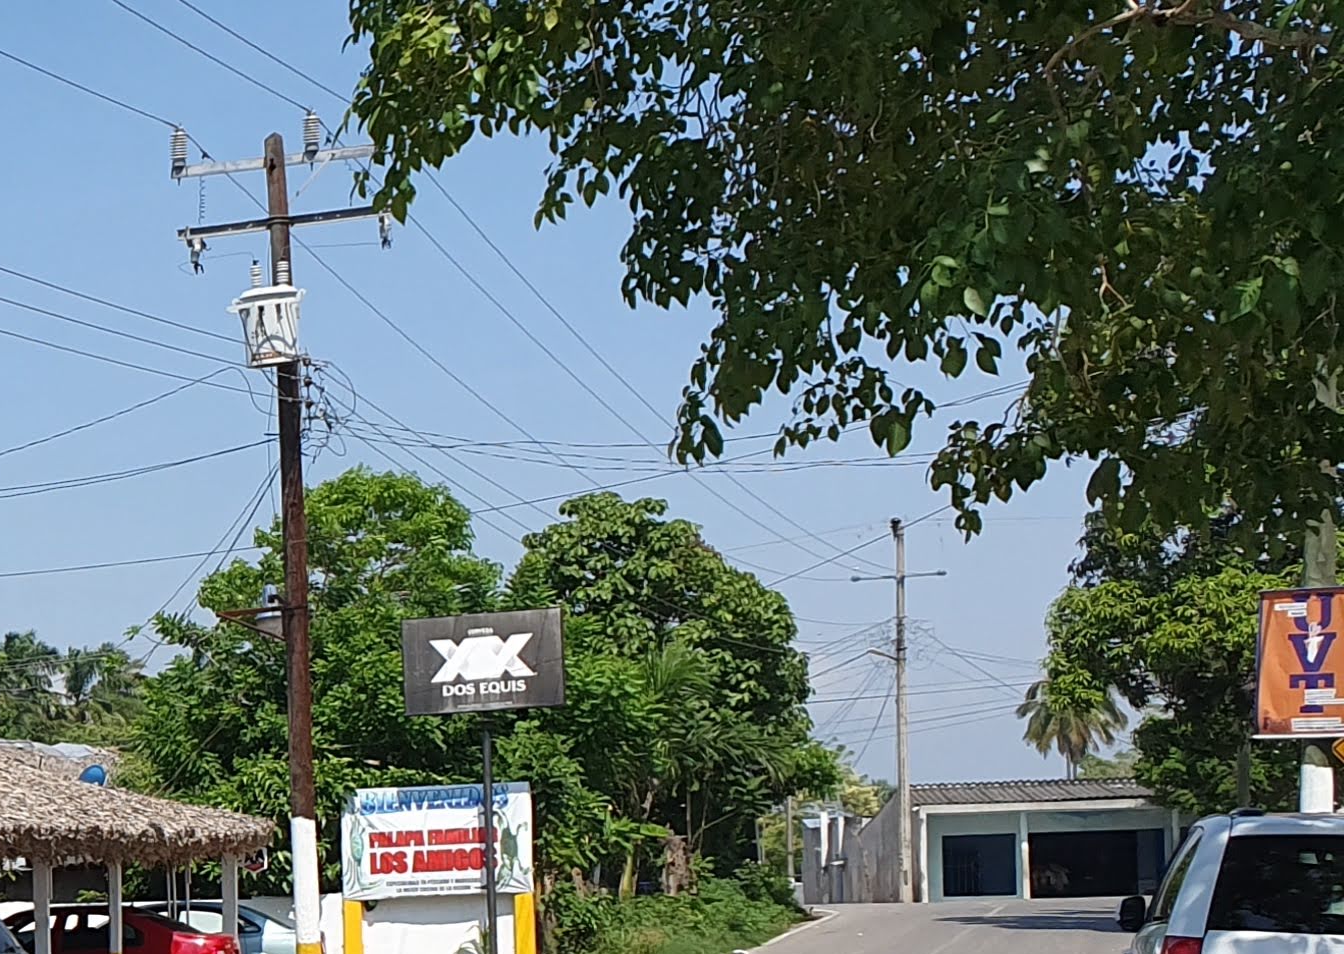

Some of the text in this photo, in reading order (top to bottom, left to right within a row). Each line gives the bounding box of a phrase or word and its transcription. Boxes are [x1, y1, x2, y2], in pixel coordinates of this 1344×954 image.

[442, 679, 527, 697] DOS EQUIS
[360, 784, 509, 815] BIENVENIDS
[369, 830, 425, 848] PALAPA
[370, 851, 409, 875] LOS
